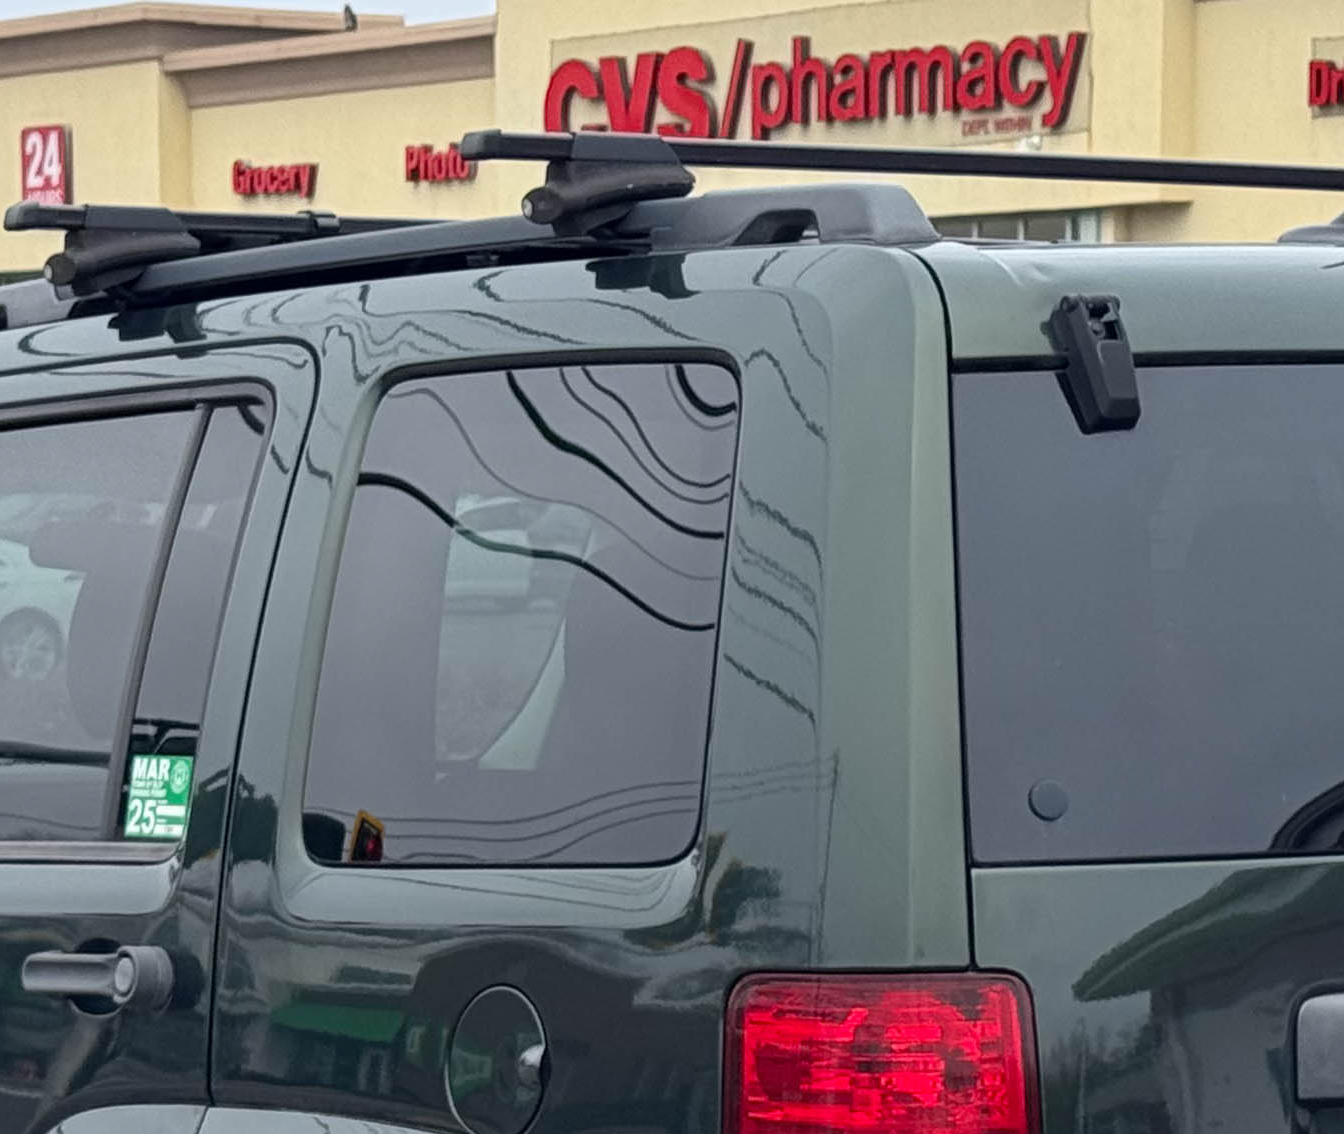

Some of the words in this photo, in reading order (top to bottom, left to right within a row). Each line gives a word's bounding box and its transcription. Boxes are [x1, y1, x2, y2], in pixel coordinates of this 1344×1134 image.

[544, 30, 1087, 138] CVS/pharmacy
[24, 130, 62, 189] 24
[405, 145, 471, 183] Photo
[233, 160, 313, 199] Grocery
[132, 756, 171, 780] MAR
[125, 799, 156, 834] 25
